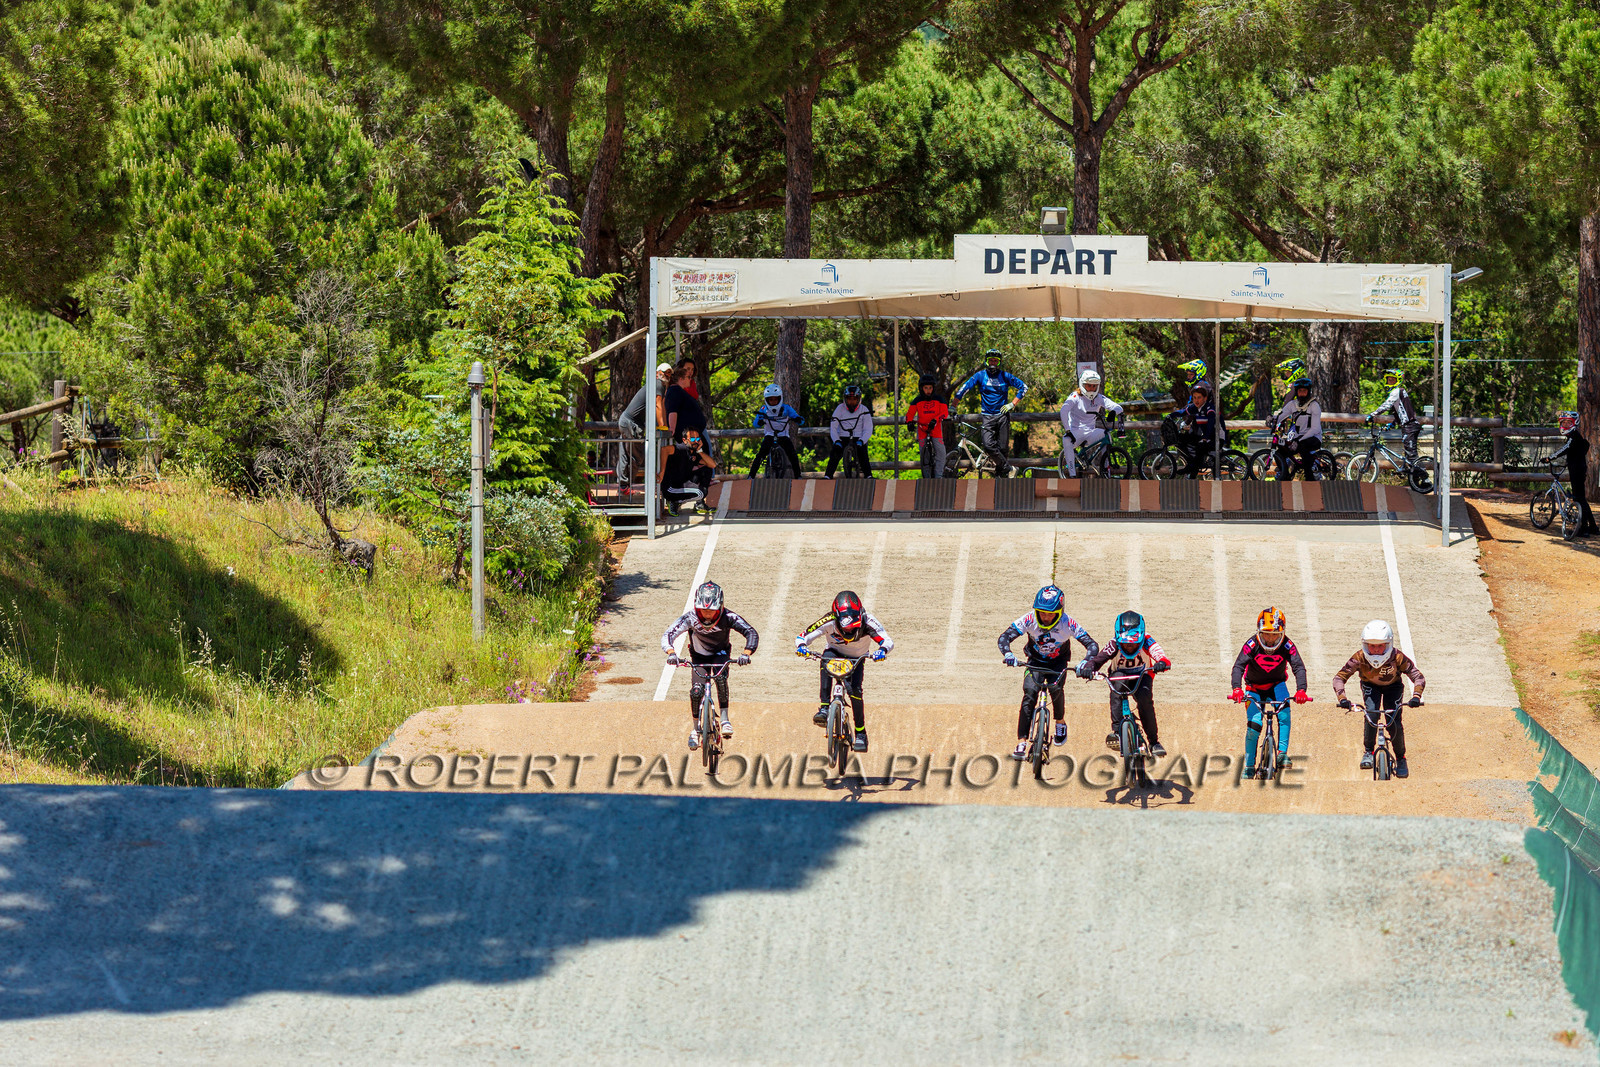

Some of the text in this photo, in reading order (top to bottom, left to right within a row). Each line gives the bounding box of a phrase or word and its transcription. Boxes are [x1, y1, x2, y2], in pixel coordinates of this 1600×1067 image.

[984, 248, 1118, 275] DEPART
[1375, 275, 1422, 287] BASSO
[800, 287, 854, 297] Sainte-Maxime
[1230, 290, 1285, 300] Sainte-Maxime
[1117, 655, 1144, 668] FOX
